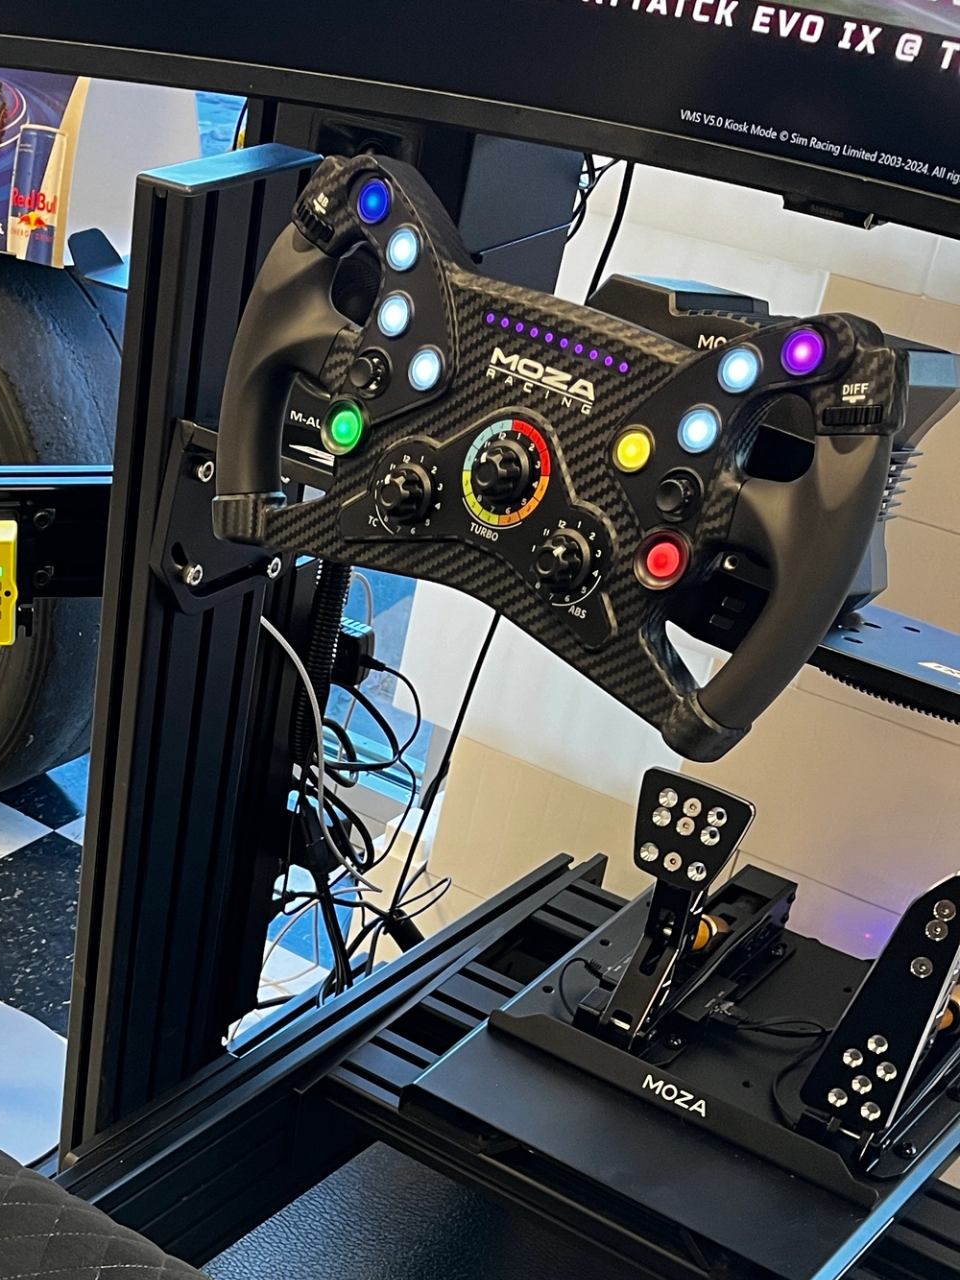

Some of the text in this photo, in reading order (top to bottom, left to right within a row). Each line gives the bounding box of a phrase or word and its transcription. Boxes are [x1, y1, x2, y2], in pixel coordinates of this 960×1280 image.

[751, 5, 825, 44] EVO
[837, 21, 882, 55] IX
[941, 40, 960, 70] T
[680, 109, 701, 123] VMS
[703, 113, 723, 128] V5.0
[724, 118, 749, 133] Kiosk
[750, 124, 778, 140] Mode
[790, 132, 808, 147] Sim
[809, 137, 841, 157] Racing
[842, 145, 878, 162] Limited
[877, 153, 930, 176] 2003-2024.
[931, 166, 946, 179] All
[946, 171, 960, 186] rig
[11, 187, 35, 209] Red
[490, 346, 595, 401] MOZA
[486, 368, 592, 415] RACING
[842, 382, 870, 396] DIFF
[498, 432, 507, 441] 12
[516, 432, 522, 440] 1
[528, 443, 535, 452] 2
[535, 460, 541, 469] 3
[420, 455, 425, 463] 1
[431, 465, 438, 474] 2
[437, 482, 444, 491] 3
[368, 515, 379, 528] TC
[558, 520, 567, 529] 12
[577, 521, 582, 529] 1
[470, 522, 499, 542] TURBO
[543, 528, 550, 536] 11
[589, 531, 596, 541] 2
[595, 549, 602, 558] 3
[592, 569, 599, 578] 4
[564, 594, 570, 603] 6
[567, 605, 588, 619] ABS
[641, 1073, 707, 1118] MOZA
